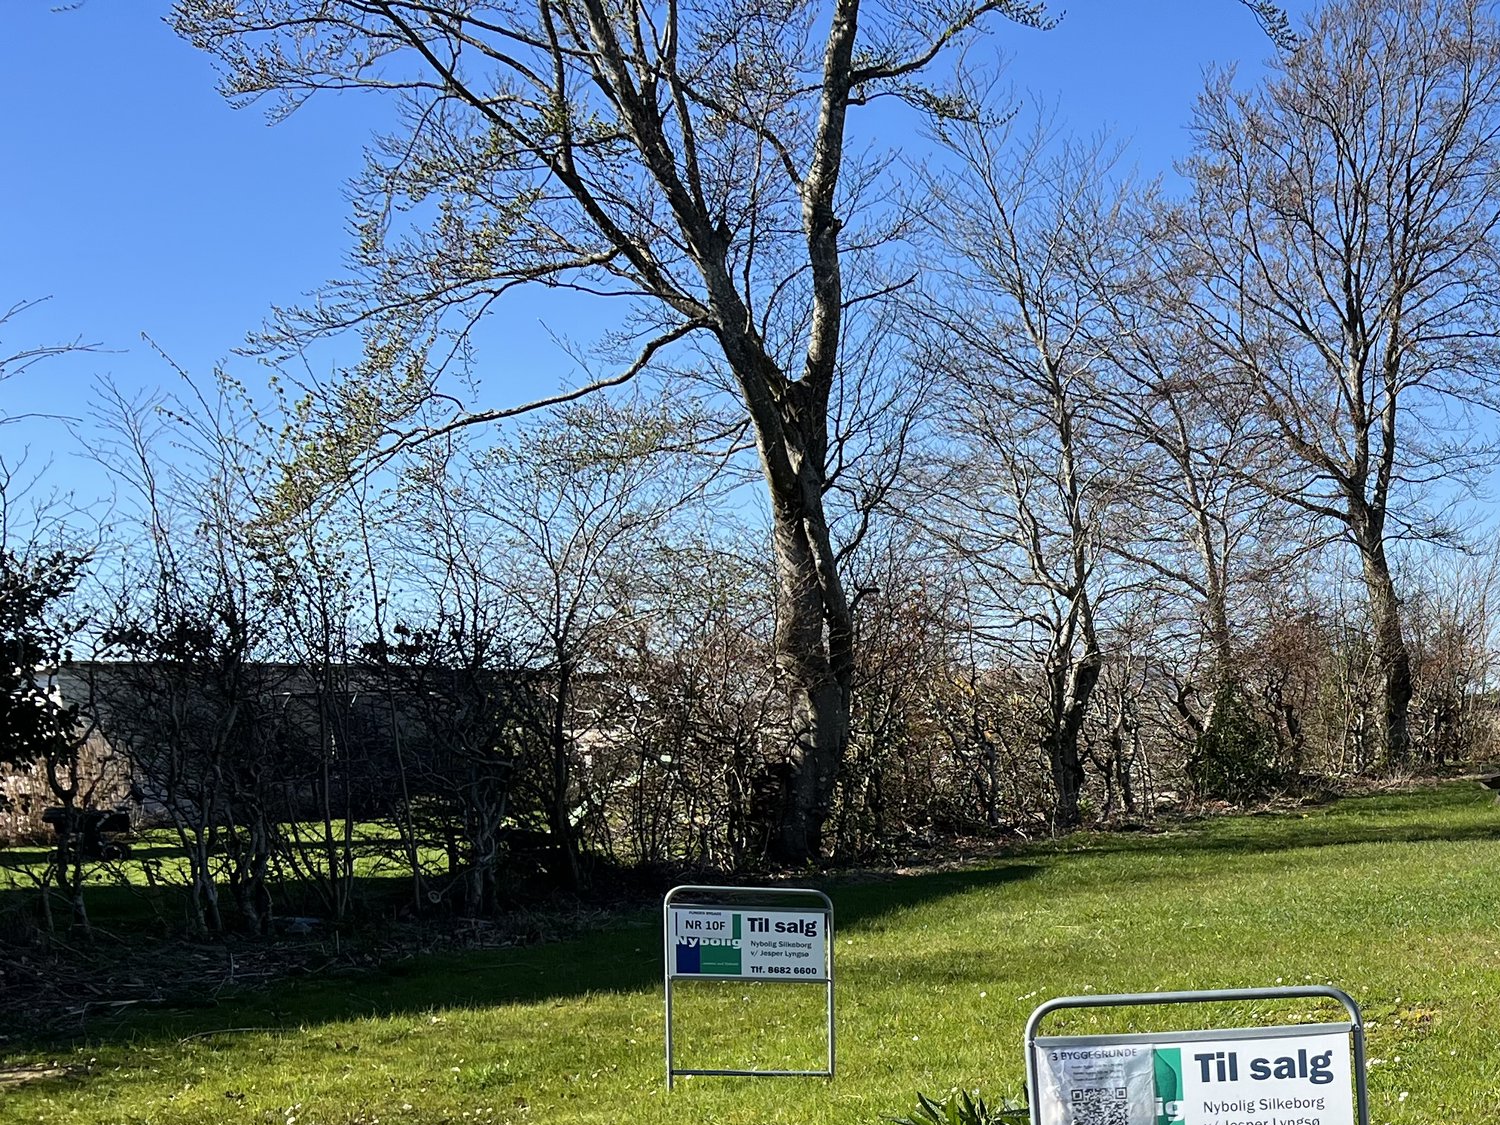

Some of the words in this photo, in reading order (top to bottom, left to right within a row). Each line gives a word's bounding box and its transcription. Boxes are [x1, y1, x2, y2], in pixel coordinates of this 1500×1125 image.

[685, 920, 702, 930] NR
[705, 921, 726, 931] 10F
[747, 917, 770, 933] Til
[774, 918, 818, 937] salg
[750, 940, 777, 948] Nybolig
[778, 940, 812, 949] Silkeborg
[784, 950, 809, 958] Lyngsø
[767, 966, 791, 974] 8682
[793, 967, 817, 975] 6600
[1052, 1052, 1058, 1061] 3
[1060, 1048, 1137, 1060] BYGGEGRUNDE
[1194, 1051, 1238, 1083] Til
[1249, 1049, 1334, 1085] salg
[1203, 1100, 1256, 1115] Nybolig
[1259, 1097, 1325, 1110] Silkeborg
